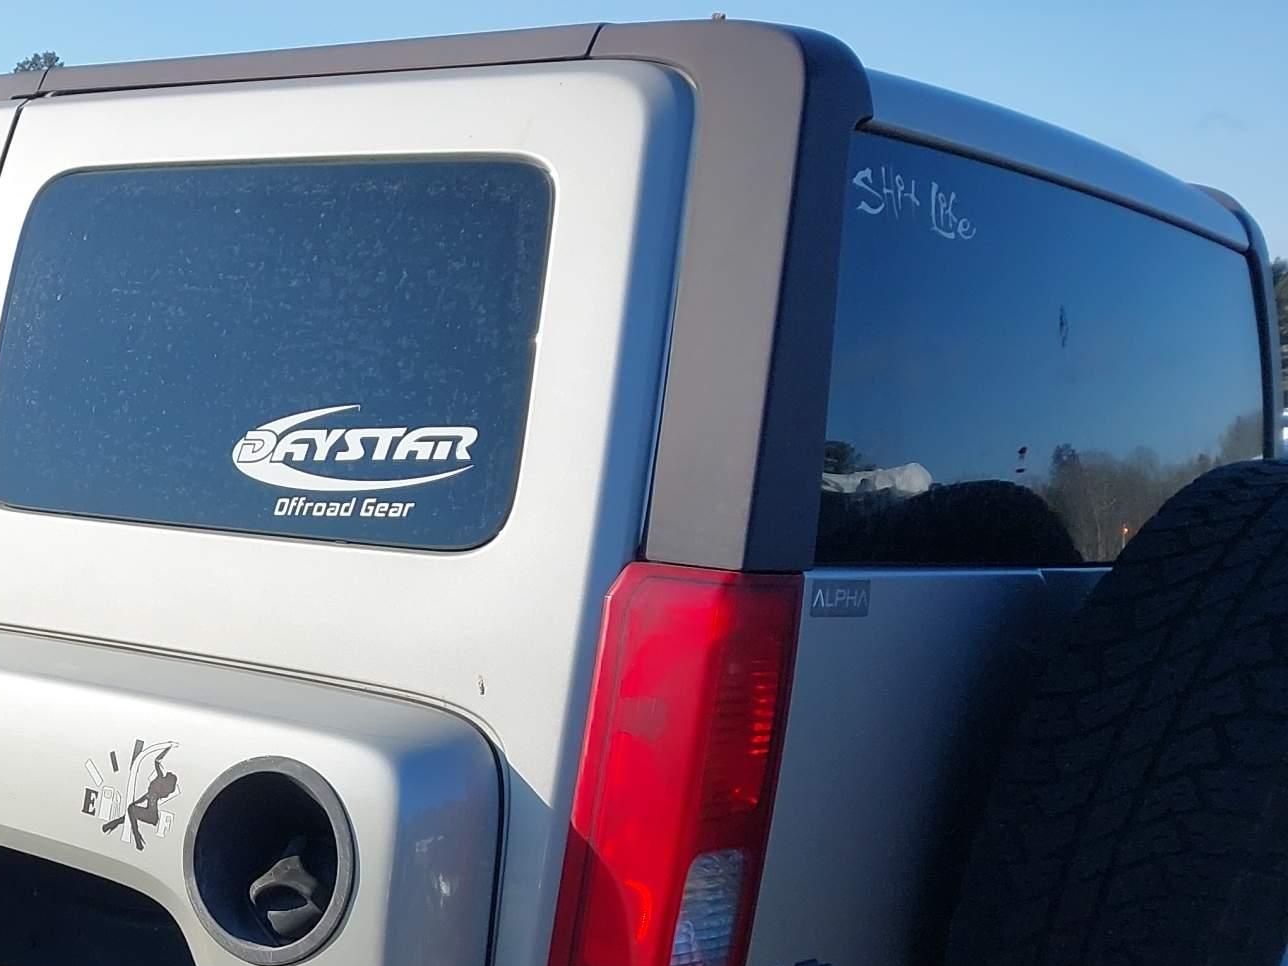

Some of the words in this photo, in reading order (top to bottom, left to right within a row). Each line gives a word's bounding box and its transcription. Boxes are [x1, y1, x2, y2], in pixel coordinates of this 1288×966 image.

[237, 426, 479, 464] DAYSTAR
[274, 496, 357, 518] Offroad
[360, 498, 416, 518] Gear
[812, 588, 869, 608] ALPHA
[82, 787, 99, 816] E
